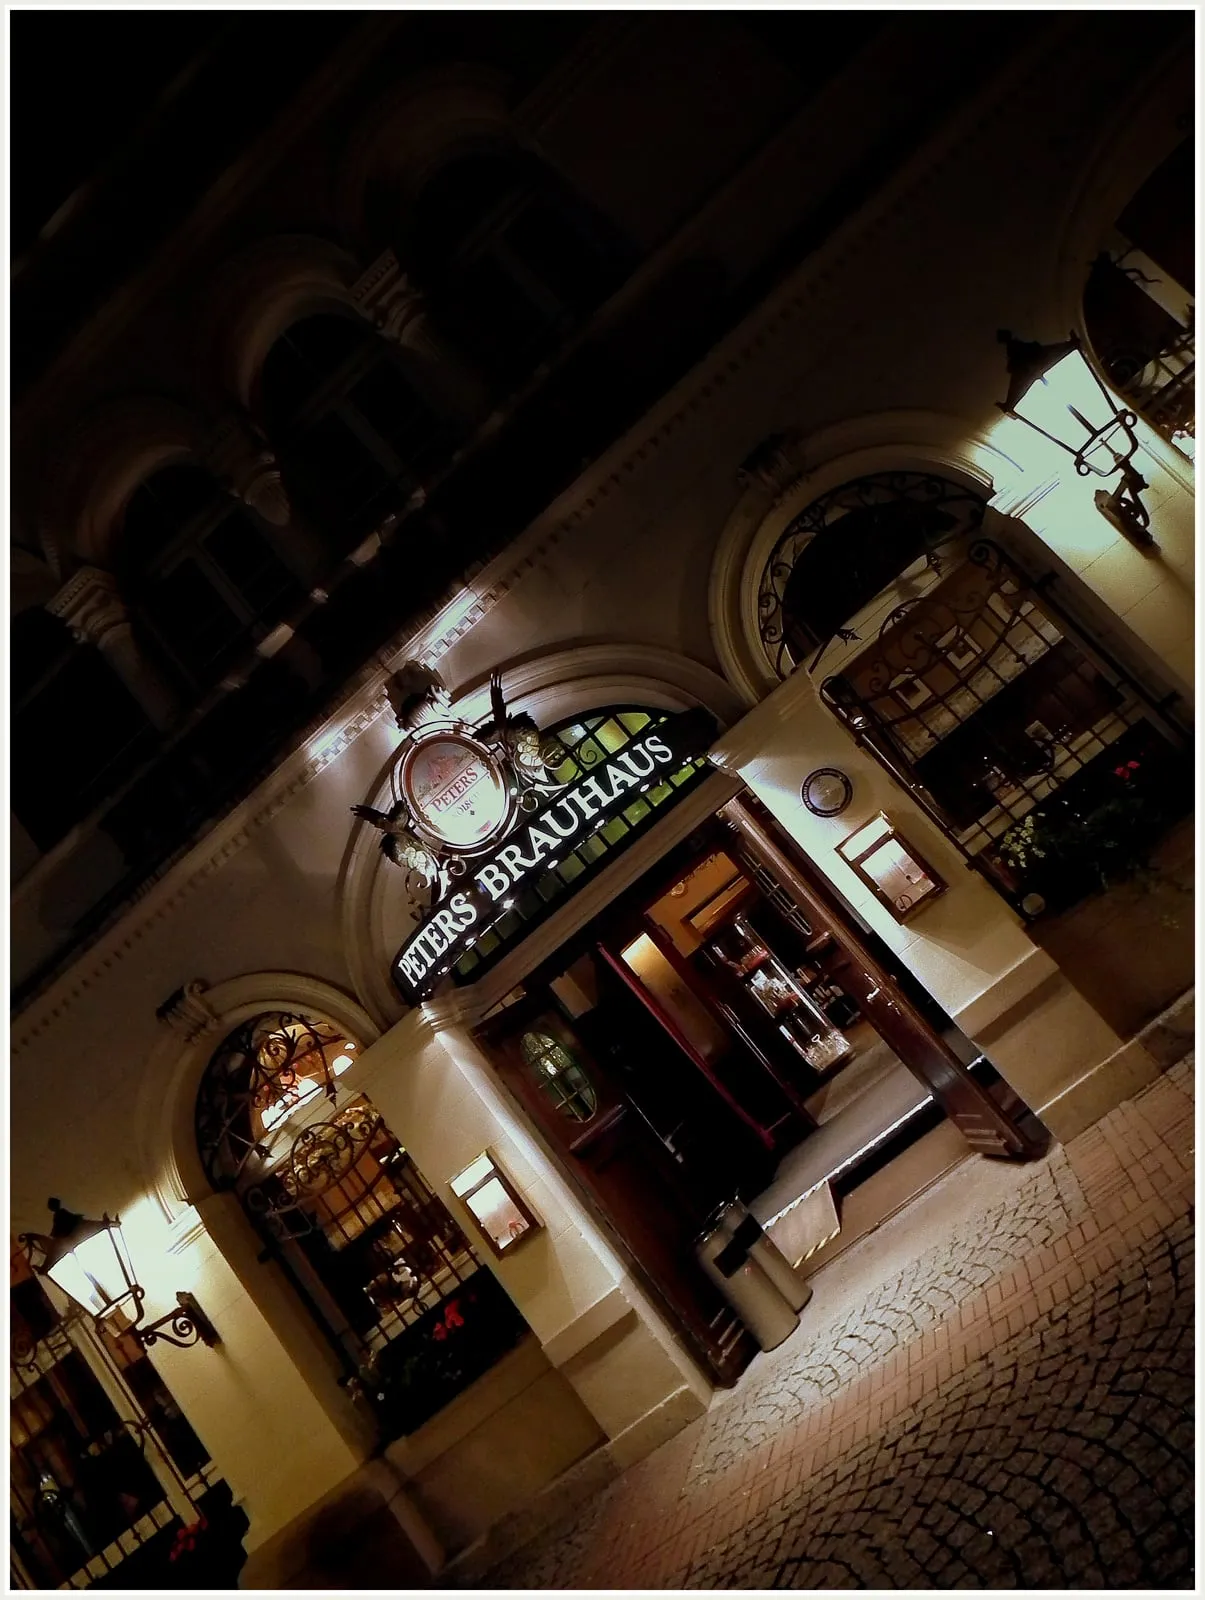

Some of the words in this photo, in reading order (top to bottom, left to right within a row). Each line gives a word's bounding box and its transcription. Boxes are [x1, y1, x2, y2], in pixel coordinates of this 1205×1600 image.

[398, 894, 477, 987] PETERS
[474, 735, 673, 900] BRAUHAUS
[431, 767, 479, 812] PETERS
